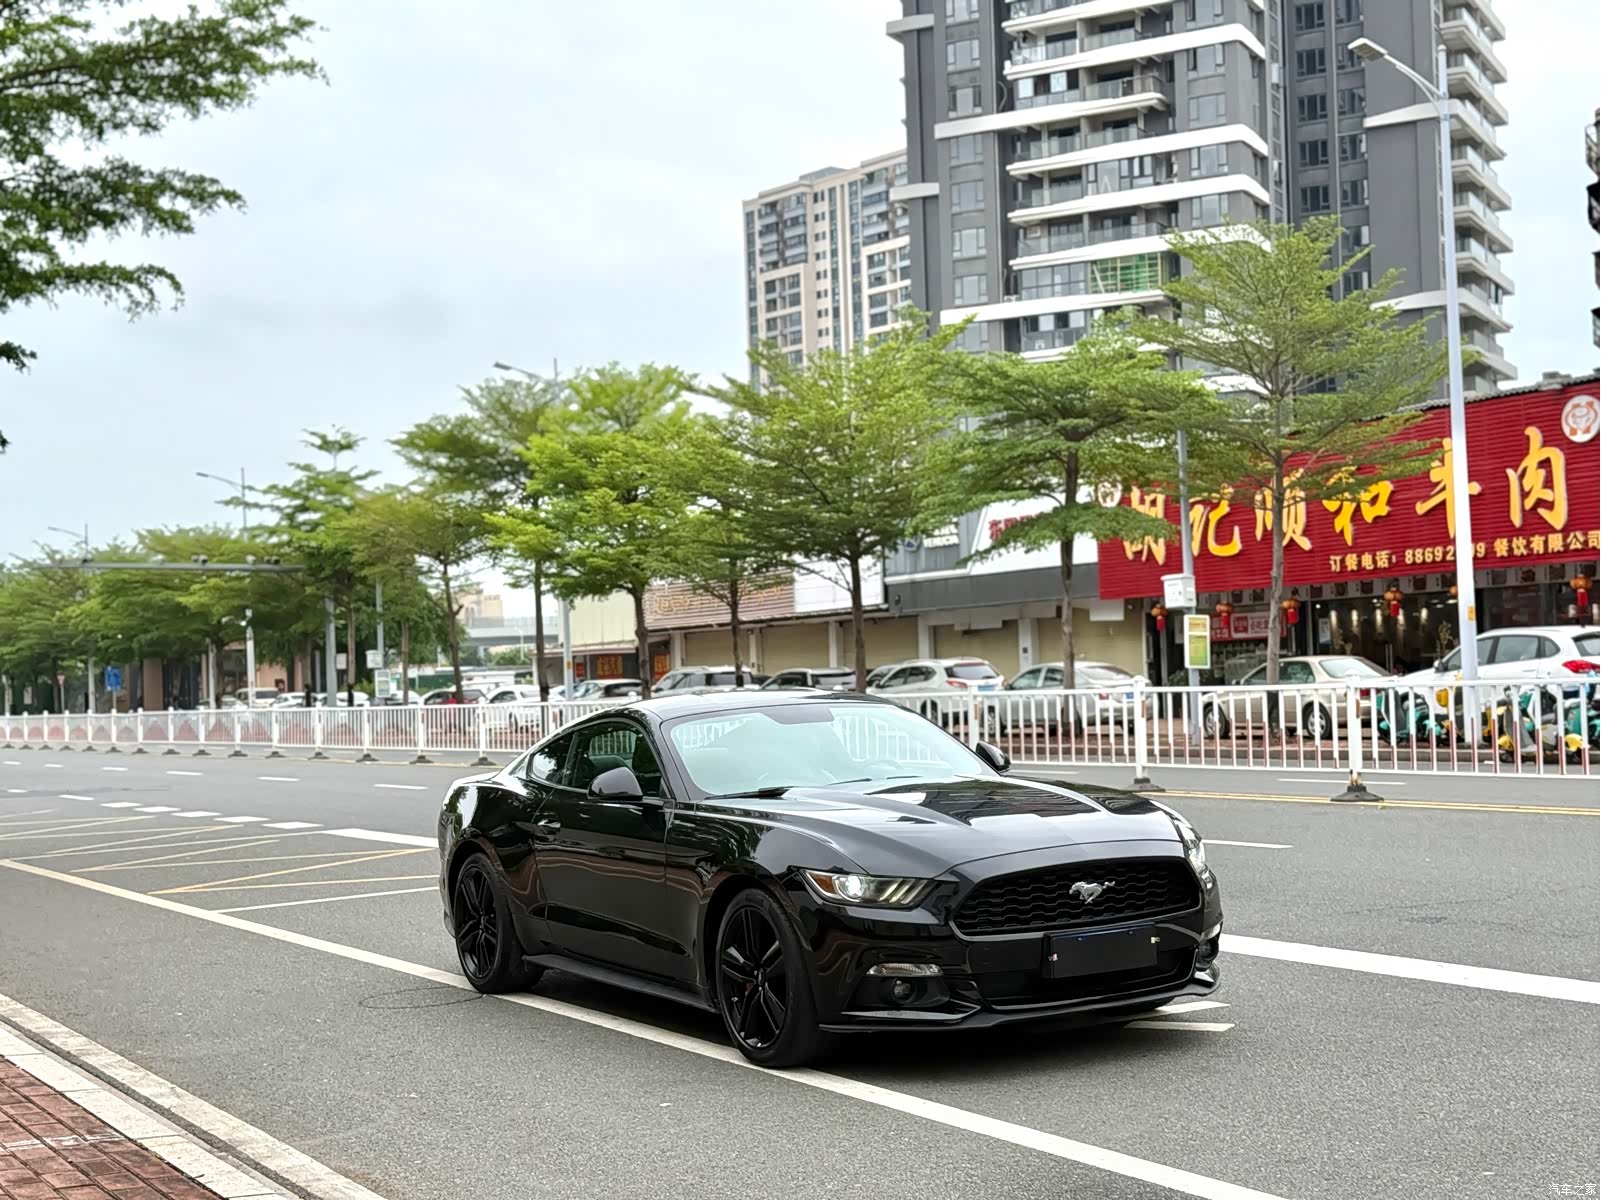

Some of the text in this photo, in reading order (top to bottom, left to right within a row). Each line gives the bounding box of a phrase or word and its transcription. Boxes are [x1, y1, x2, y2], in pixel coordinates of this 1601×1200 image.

[1405, 542, 1486, 564] 886929
[1493, 530, 1601, 558] 餐饮有限公司
